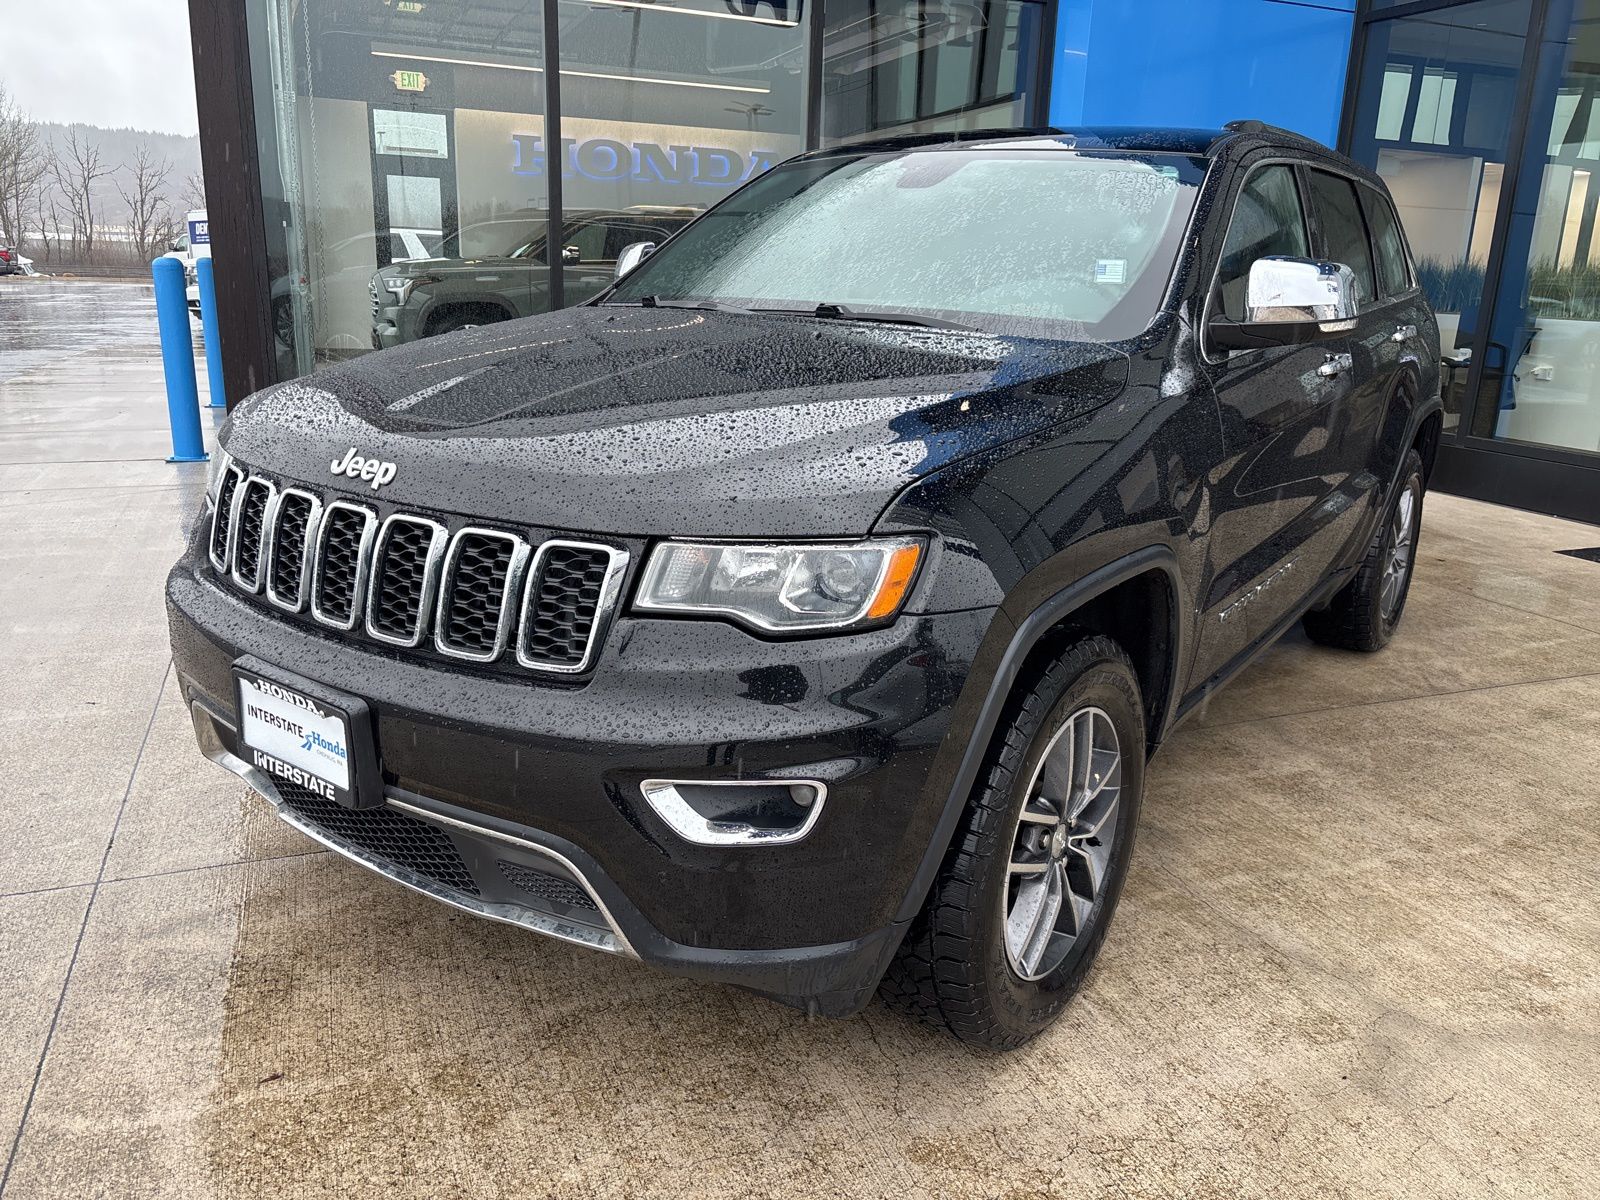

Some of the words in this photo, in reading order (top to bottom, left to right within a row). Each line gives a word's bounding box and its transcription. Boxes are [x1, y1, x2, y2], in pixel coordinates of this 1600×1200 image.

[402, 72, 419, 88] EXIT
[330, 447, 398, 490] Jeep
[258, 680, 319, 714] HONDA
[247, 703, 305, 739] INTERSTATE
[311, 730, 346, 759] Honda
[253, 750, 336, 801] INTERSTATE
